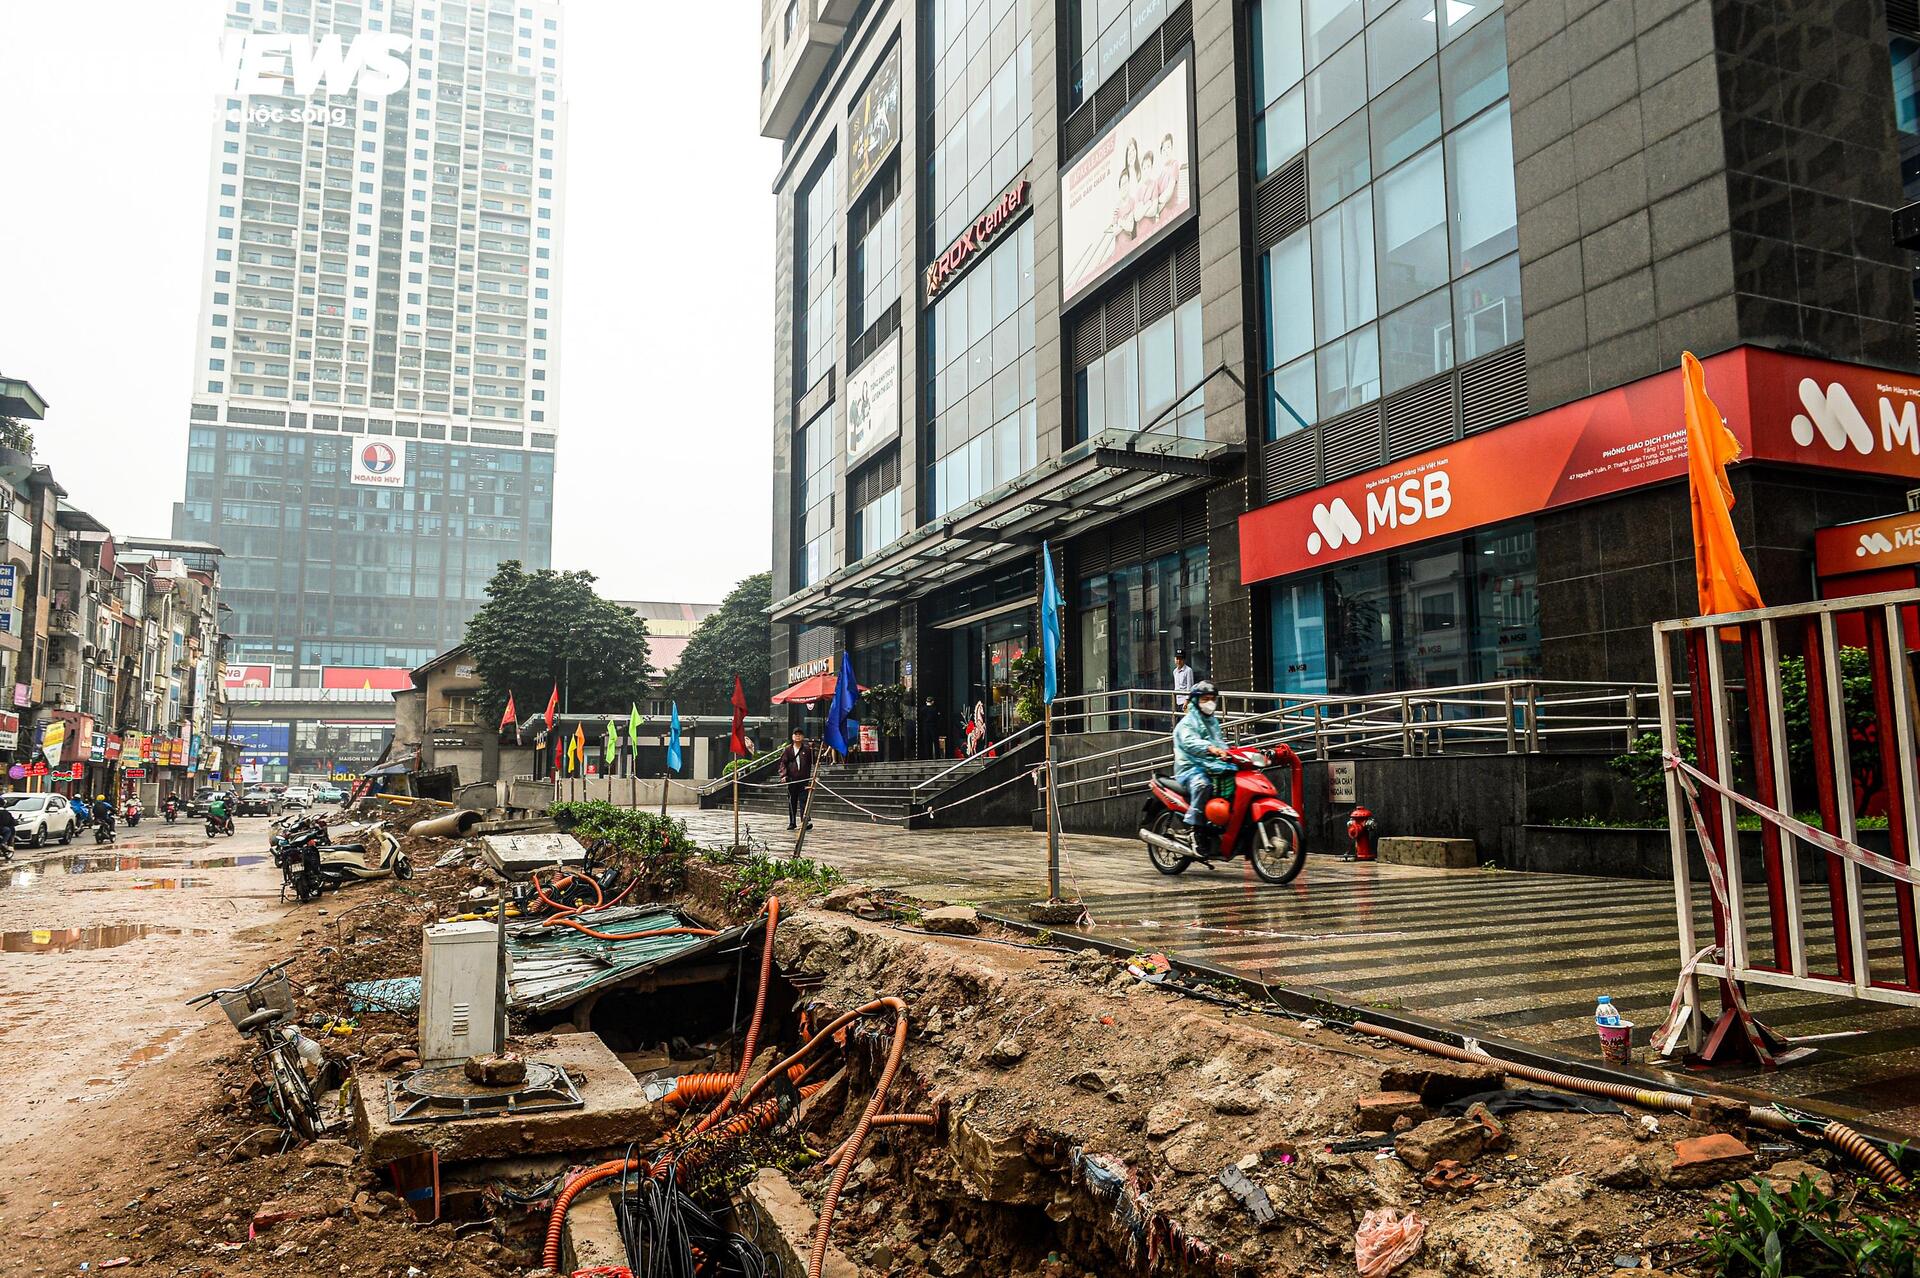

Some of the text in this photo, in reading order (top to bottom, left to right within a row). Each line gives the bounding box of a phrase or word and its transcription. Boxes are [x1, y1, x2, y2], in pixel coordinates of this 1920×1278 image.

[1103, 32, 1128, 62] DANCE
[976, 180, 1031, 242] Center
[1877, 383, 1893, 393] Ngân
[1893, 386, 1908, 396] Hàng
[1602, 429, 1687, 459] PHÒNG GIAO DỊCH THANH
[1613, 459, 1629, 469] Thanh
[1667, 445, 1683, 455] Thanh
[385, 476, 400, 484] HUY
[1365, 480, 1378, 490] Ngân
[1378, 476, 1390, 486] Hàng
[1426, 461, 1436, 471] Việt
[1437, 458, 1449, 467] Nam
[1631, 463, 1646, 473] (024)
[1366, 470, 1452, 535] MSB
[789, 658, 829, 682] HIGHLANDS
